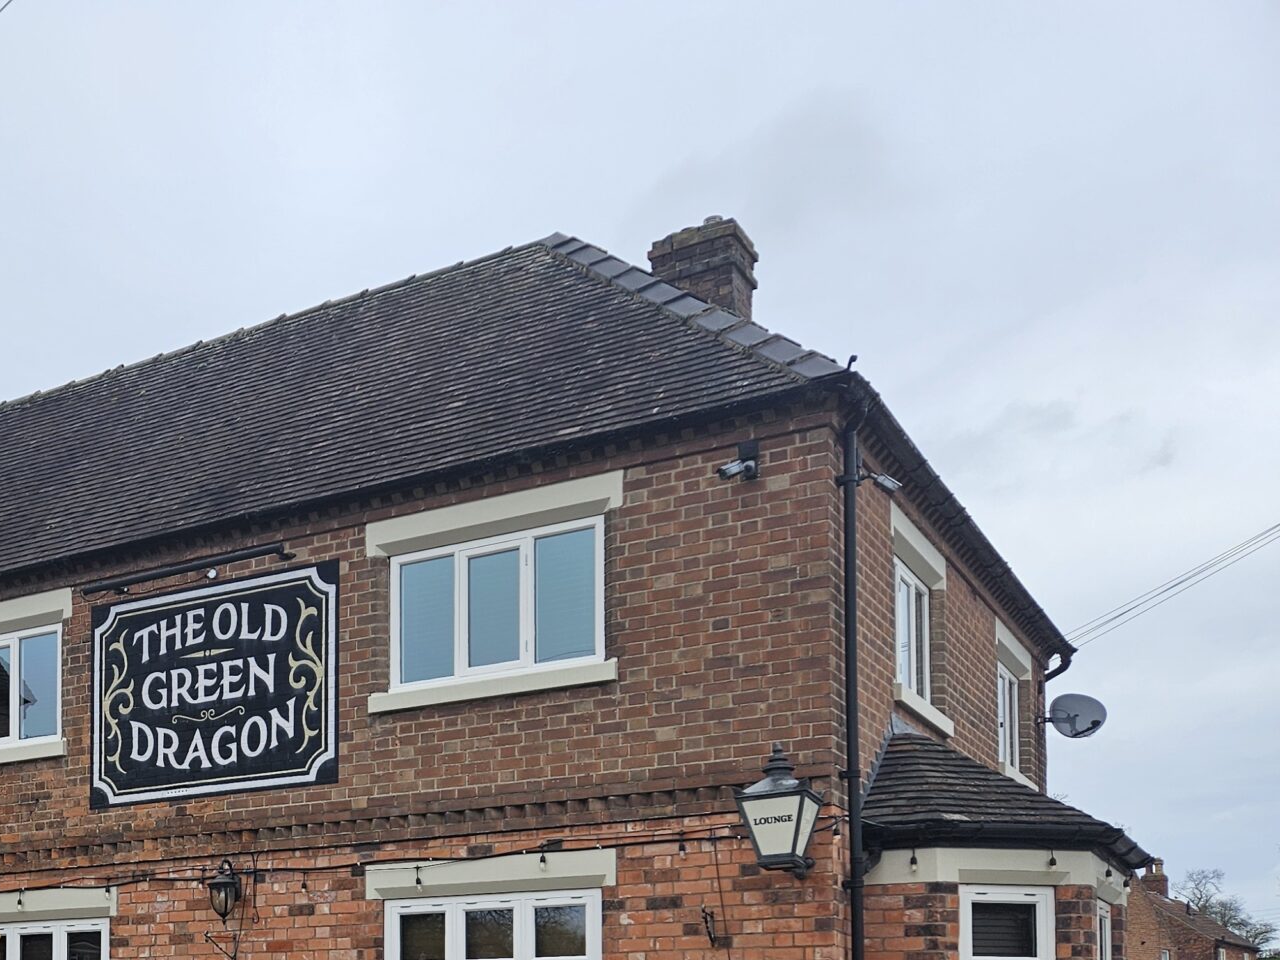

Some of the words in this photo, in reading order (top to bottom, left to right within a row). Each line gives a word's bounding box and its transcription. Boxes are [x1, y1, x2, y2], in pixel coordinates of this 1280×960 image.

[133, 608, 206, 664] THE
[212, 602, 288, 641] OLD
[141, 653, 277, 710] GREEN
[129, 696, 297, 770] DRAGON
[753, 814, 794, 826] LOUNGE
